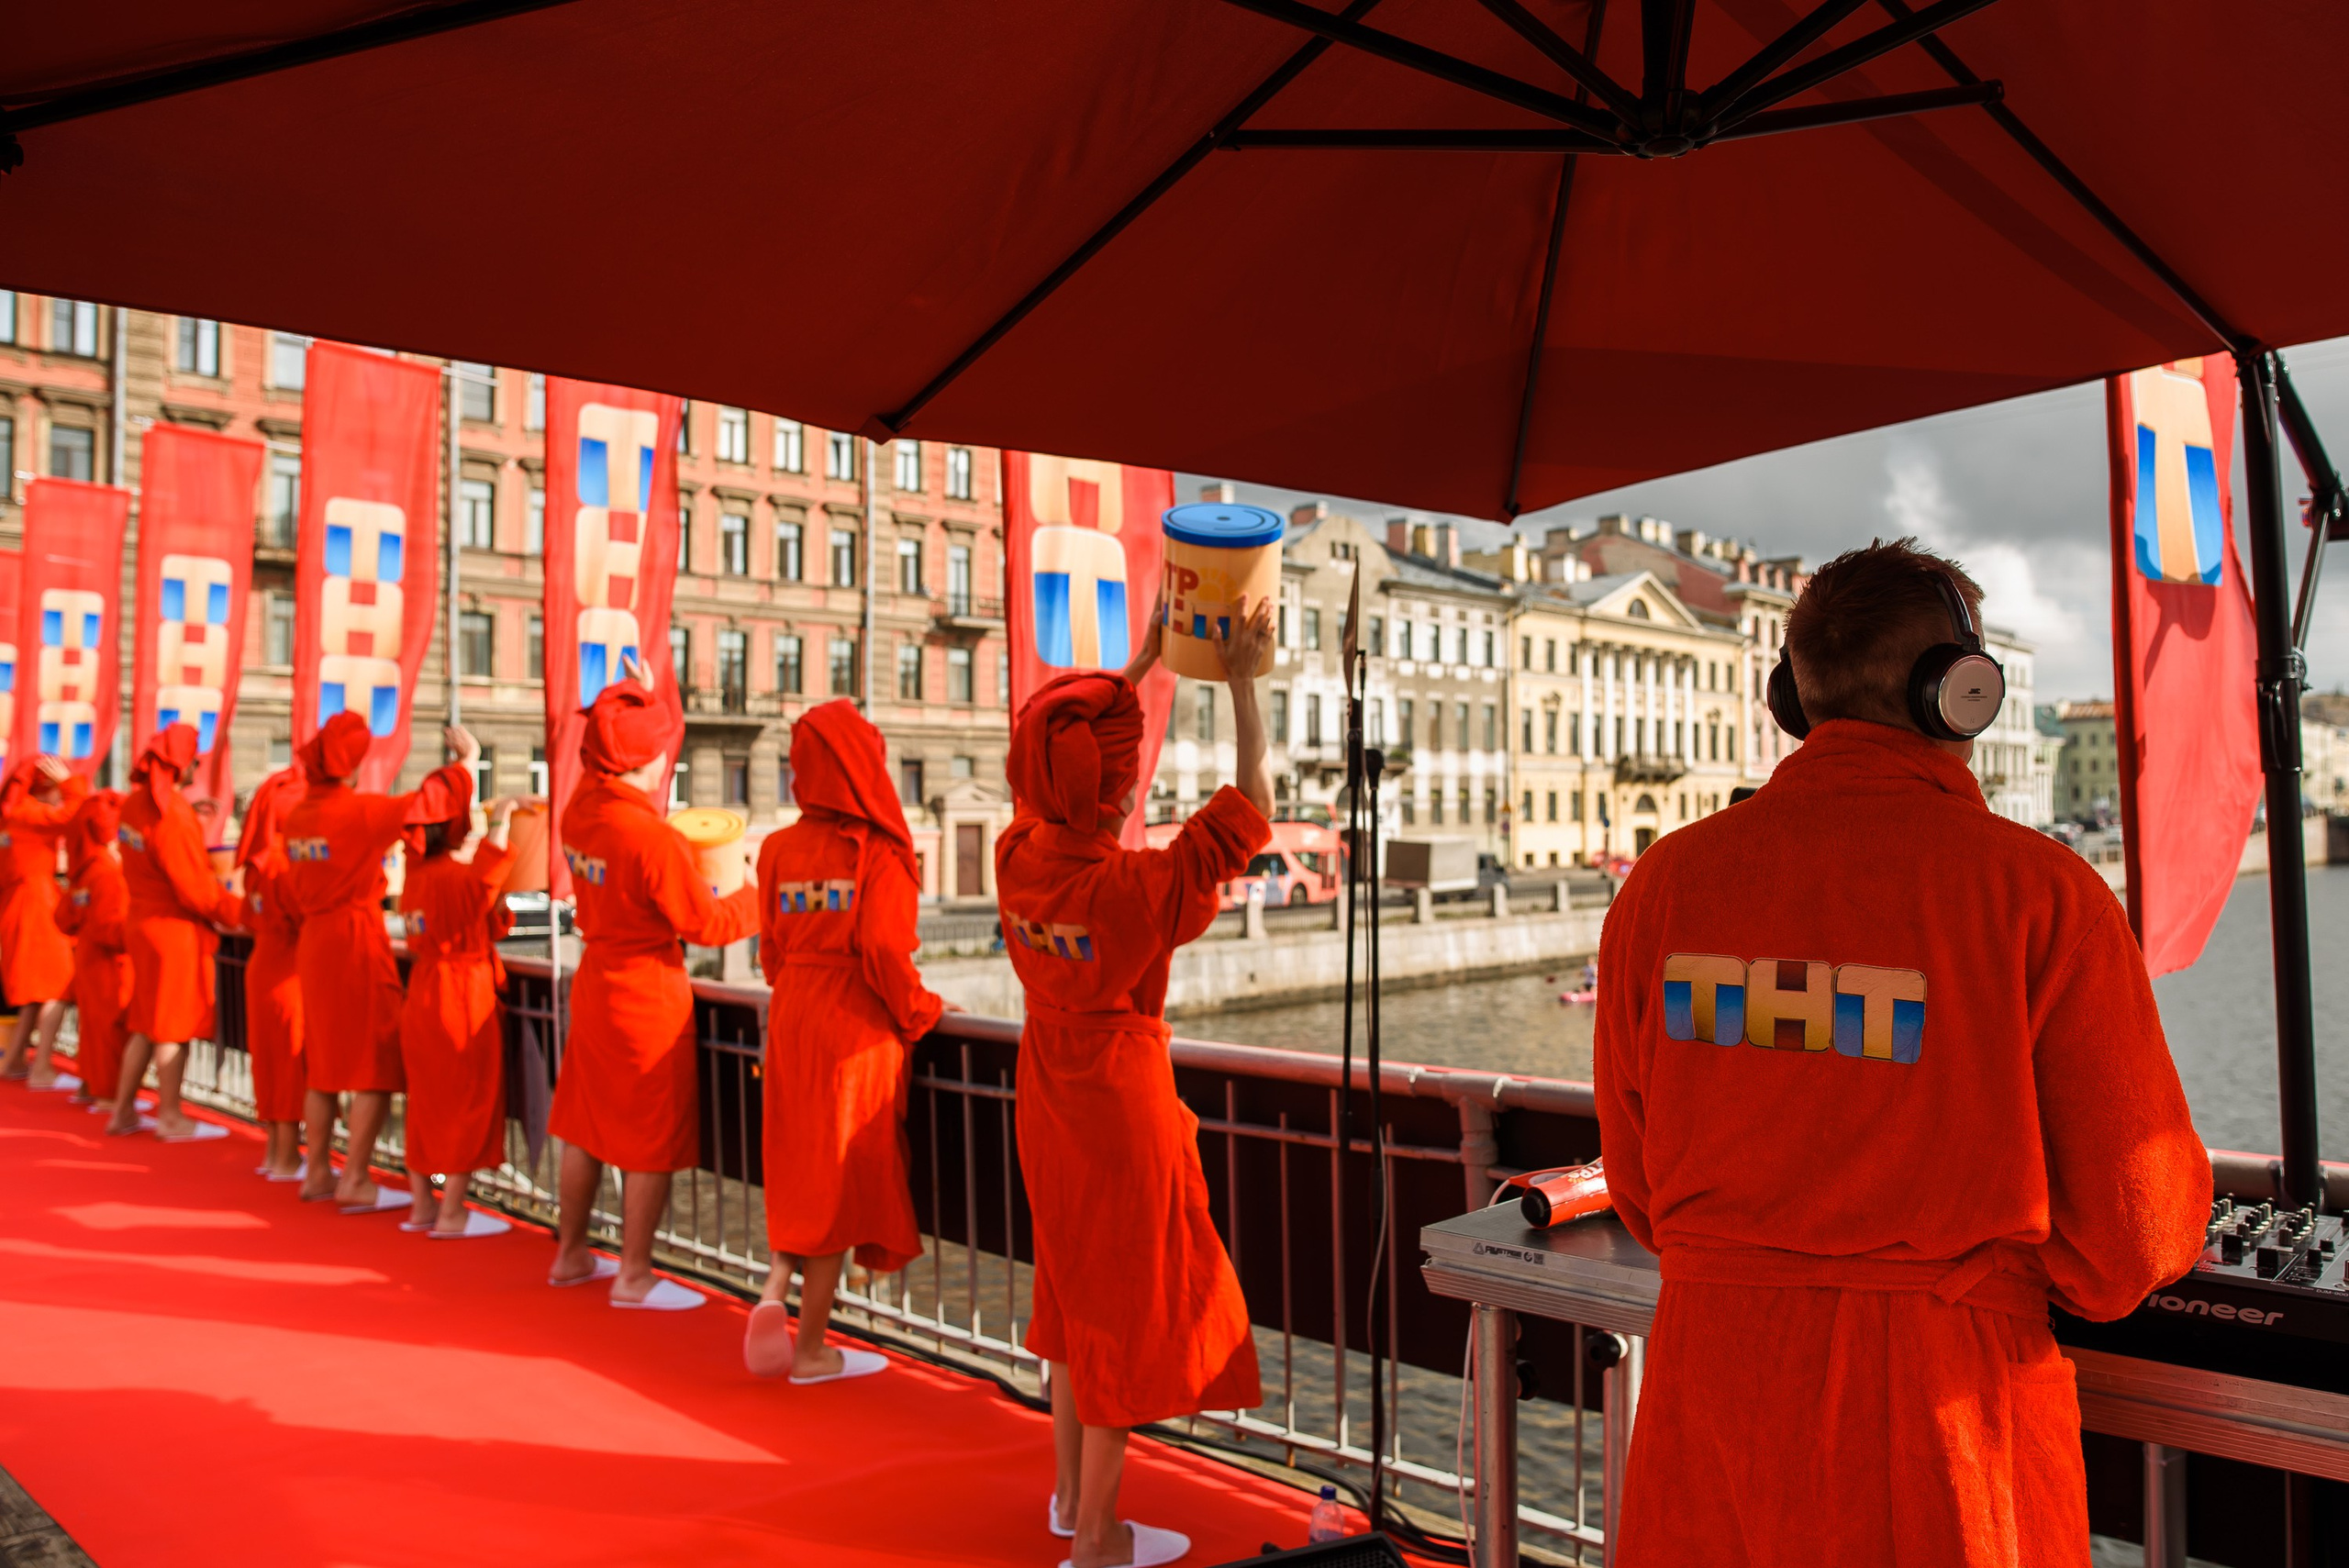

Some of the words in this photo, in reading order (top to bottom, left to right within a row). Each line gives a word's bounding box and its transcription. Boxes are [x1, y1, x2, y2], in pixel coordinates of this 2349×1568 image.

[317, 496, 406, 739] ТНТ
[1030, 452, 1130, 671] НТ
[38, 588, 106, 760] ТНТ
[778, 878, 856, 914] ТНТ
[1664, 952, 1927, 1064] ТНТ
[2148, 1293, 2284, 1326] ioneer
